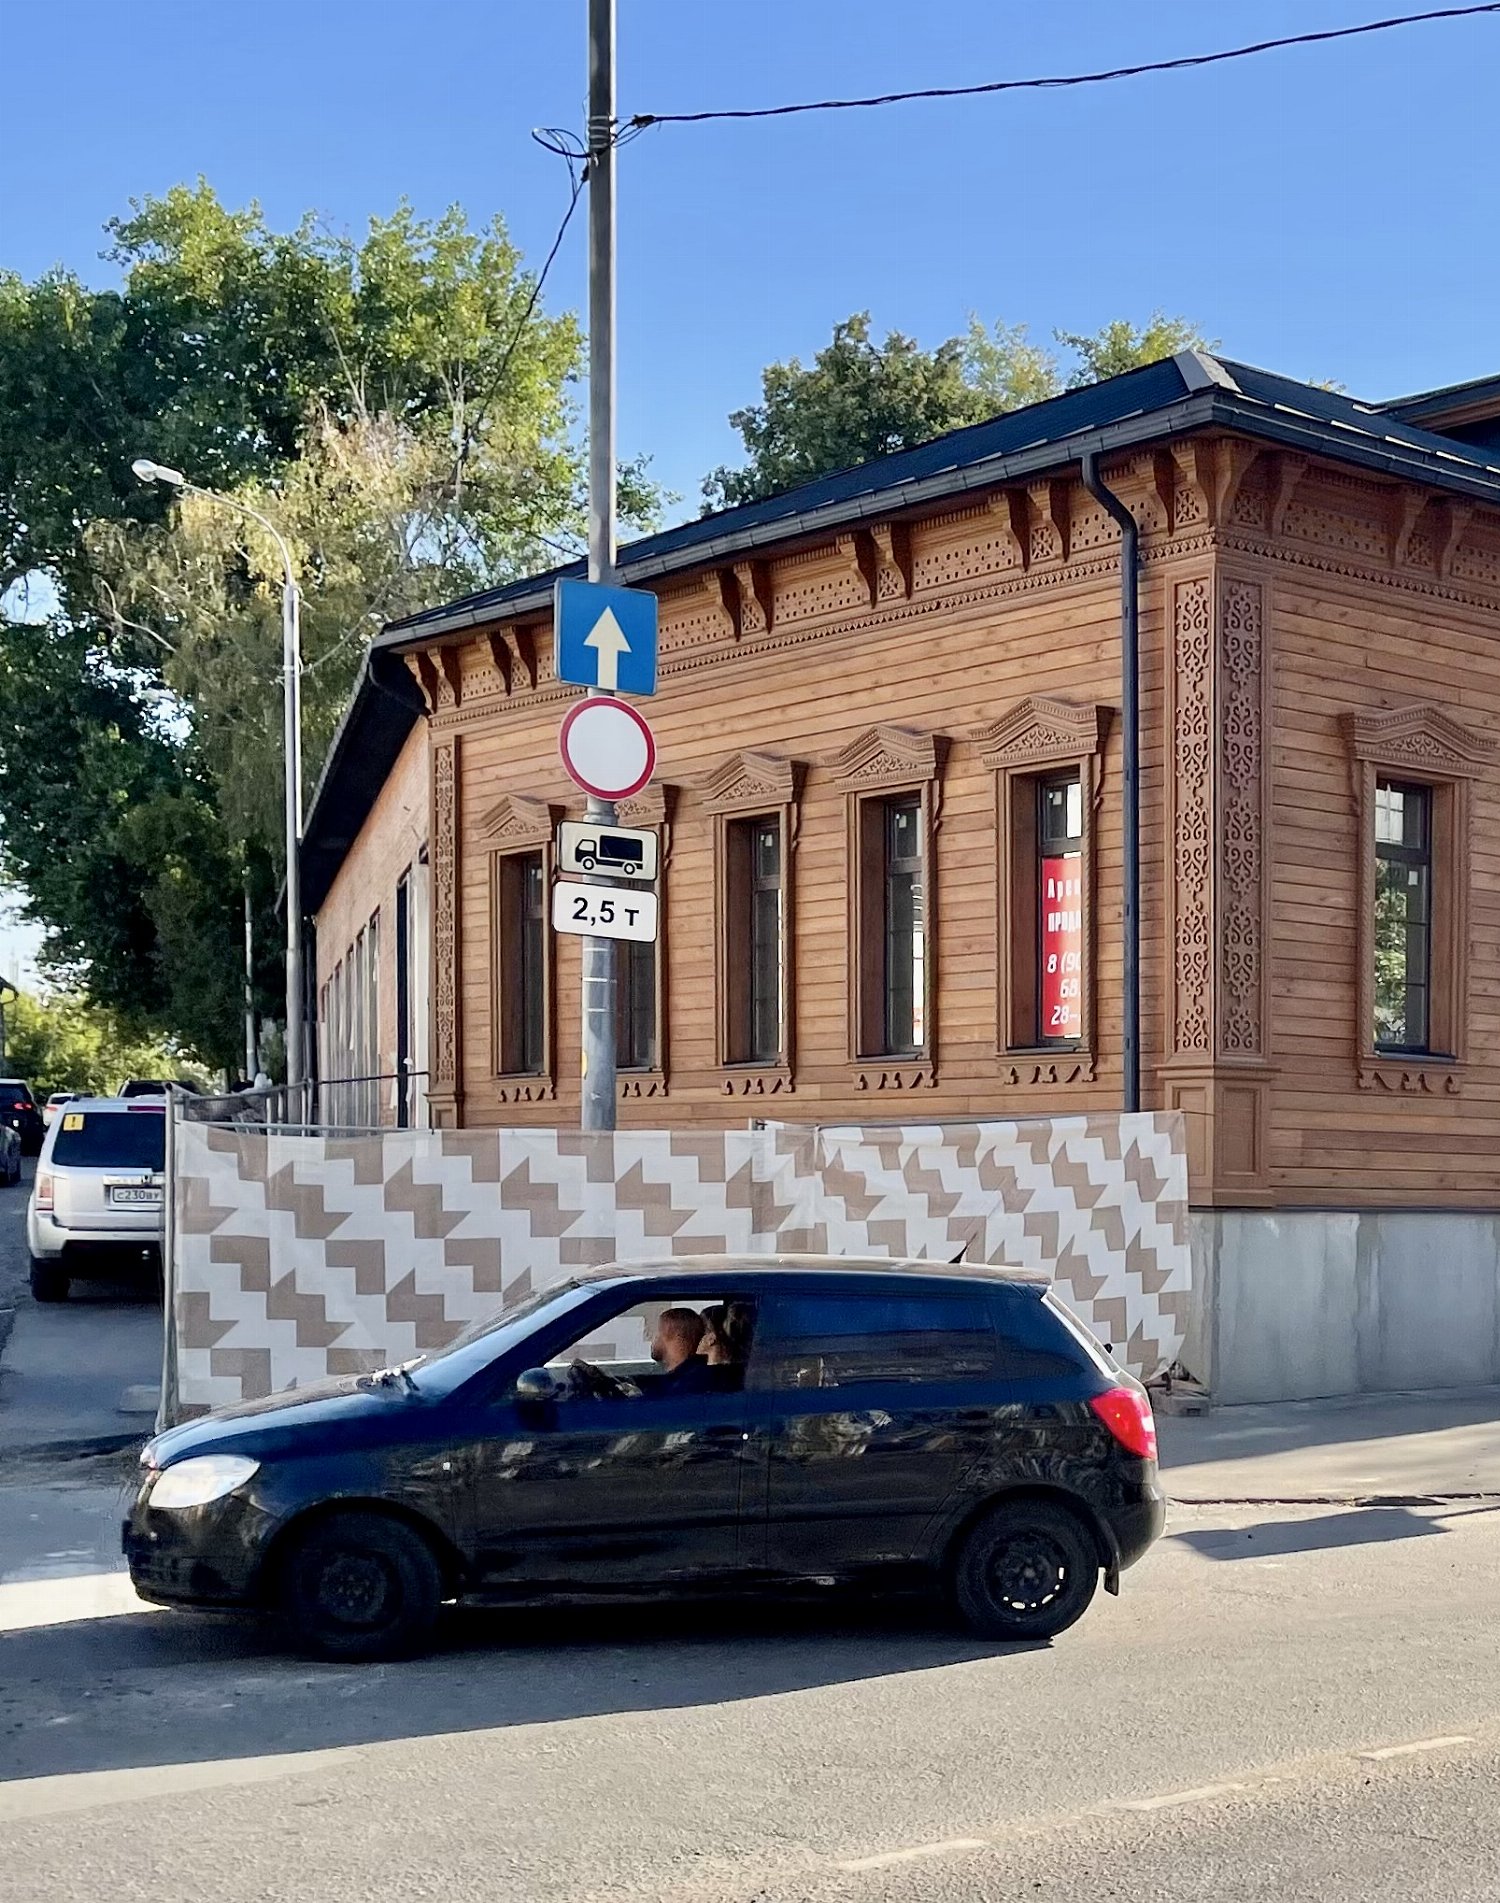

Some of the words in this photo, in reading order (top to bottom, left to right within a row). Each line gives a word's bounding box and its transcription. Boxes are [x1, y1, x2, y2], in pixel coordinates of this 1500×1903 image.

[572, 897, 615, 926] 2,5
[1047, 953, 1058, 973] 8
[1060, 978, 1081, 999] 68
[1051, 1004, 1081, 1025] 28-
